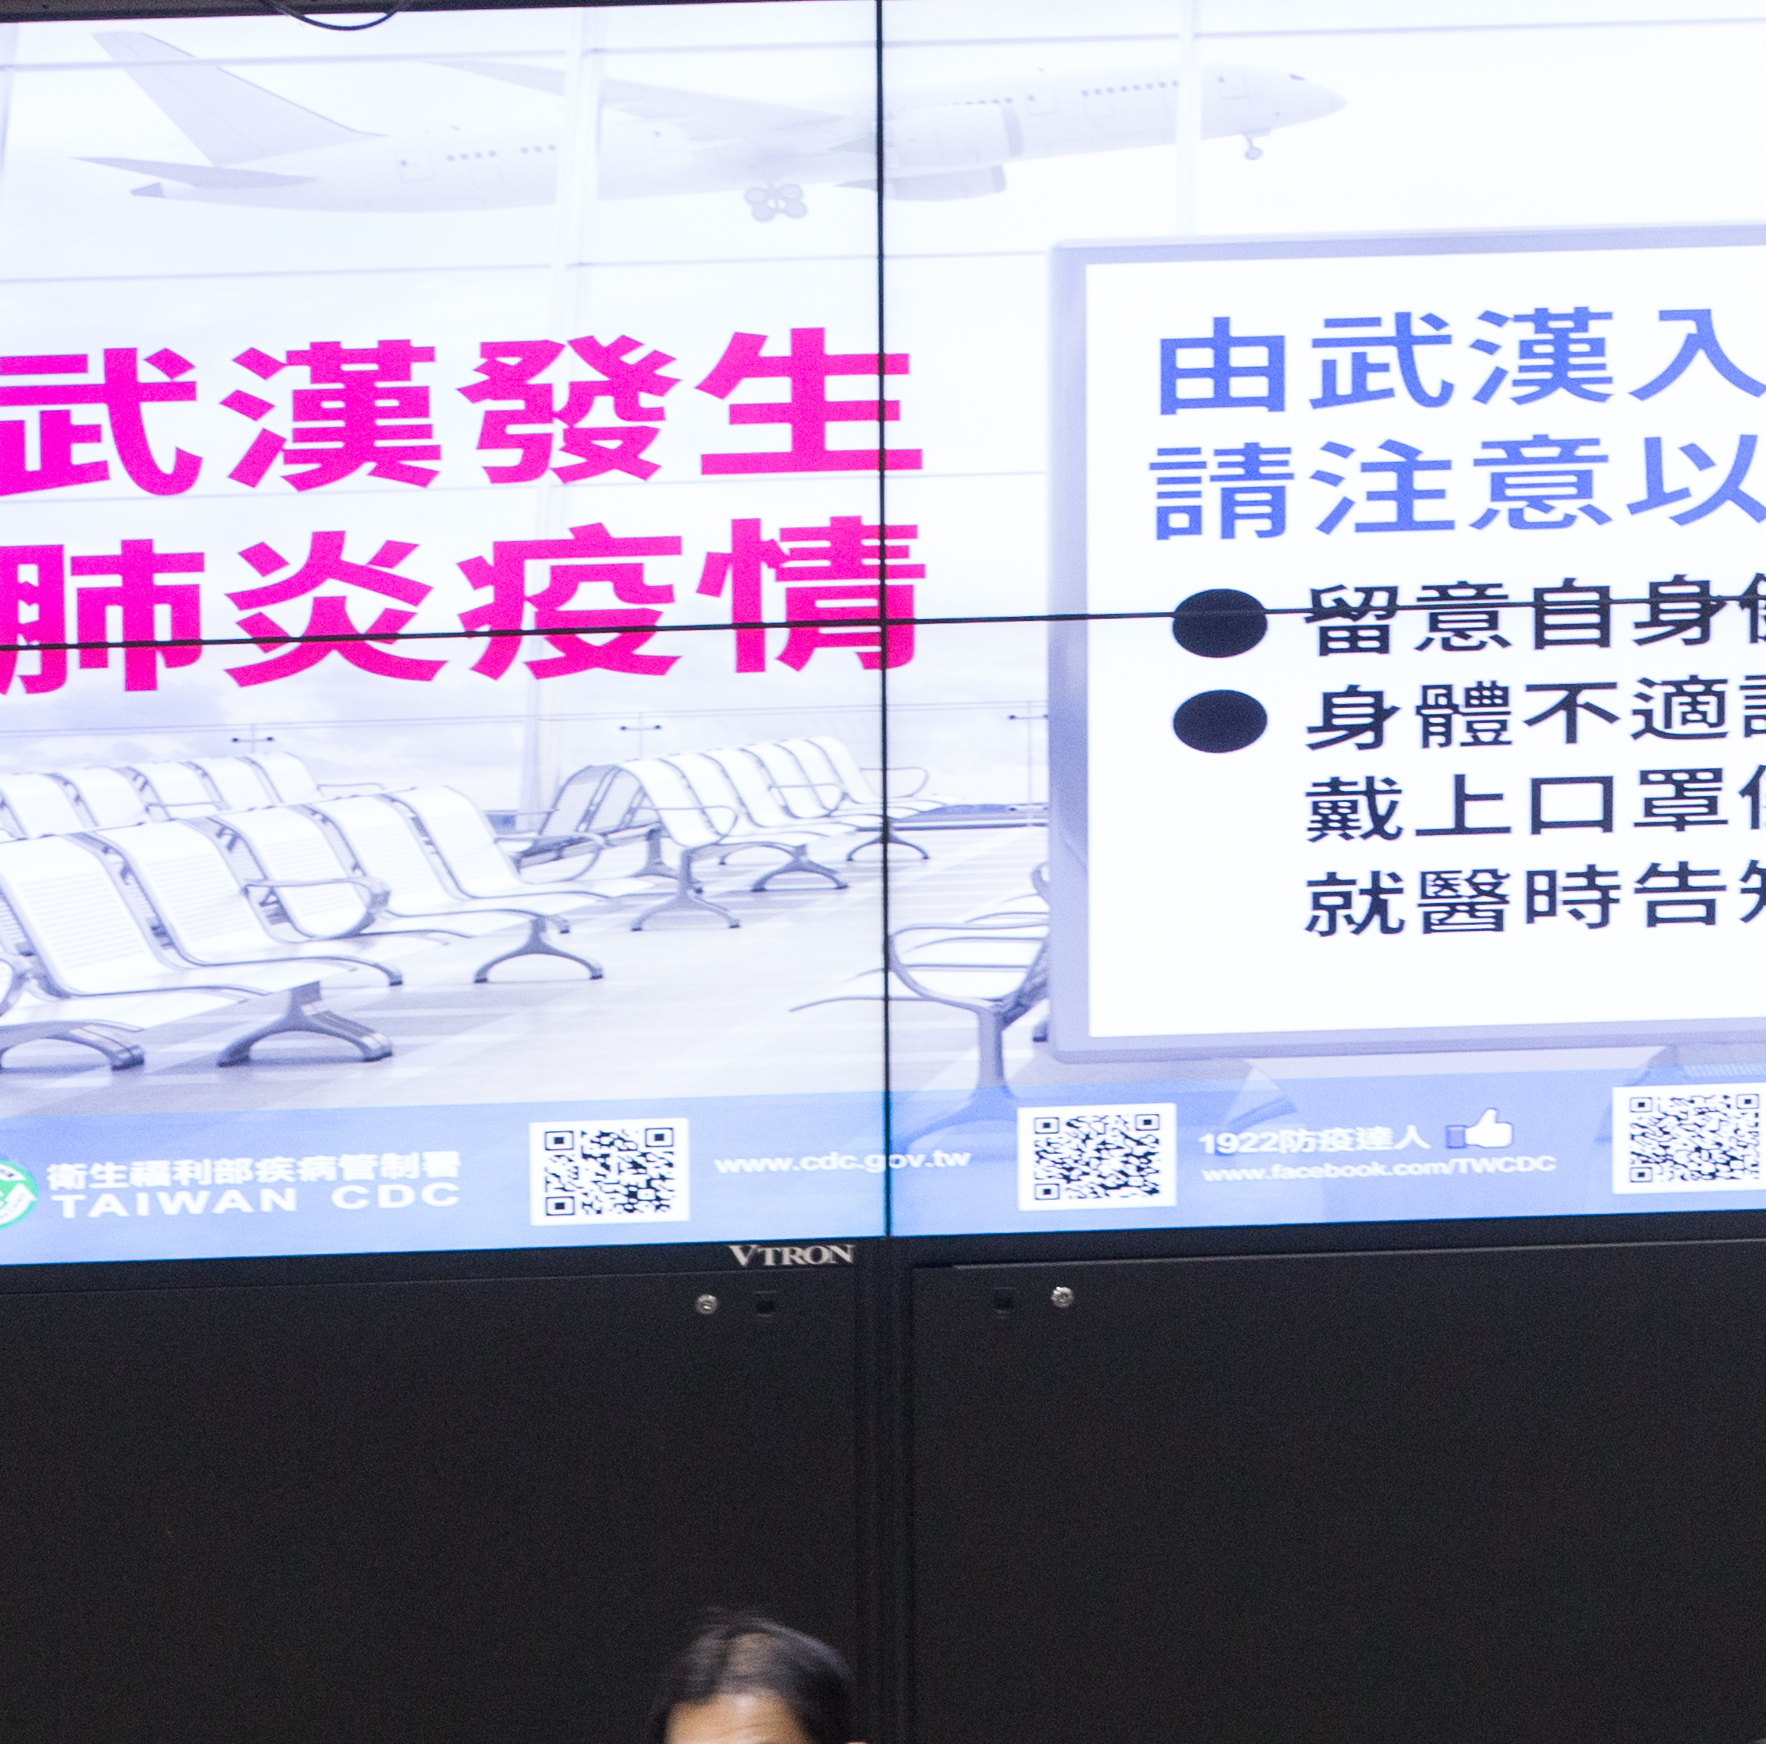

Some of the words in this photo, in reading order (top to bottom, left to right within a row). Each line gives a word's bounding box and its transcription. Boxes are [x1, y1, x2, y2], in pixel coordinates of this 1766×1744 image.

[1198, 1124, 1432, 1156] 1922防疫達人
[46, 1150, 464, 1191] 衛生福利部疾病管制署
[714, 1150, 973, 1175] www.cdc.gov.tw
[1201, 1154, 1558, 1183] www.facebook.com/TWCDC
[50, 1187, 298, 1219] TAIWAN
[331, 1182, 461, 1211] CDC
[728, 1243, 855, 1267] VTRON
